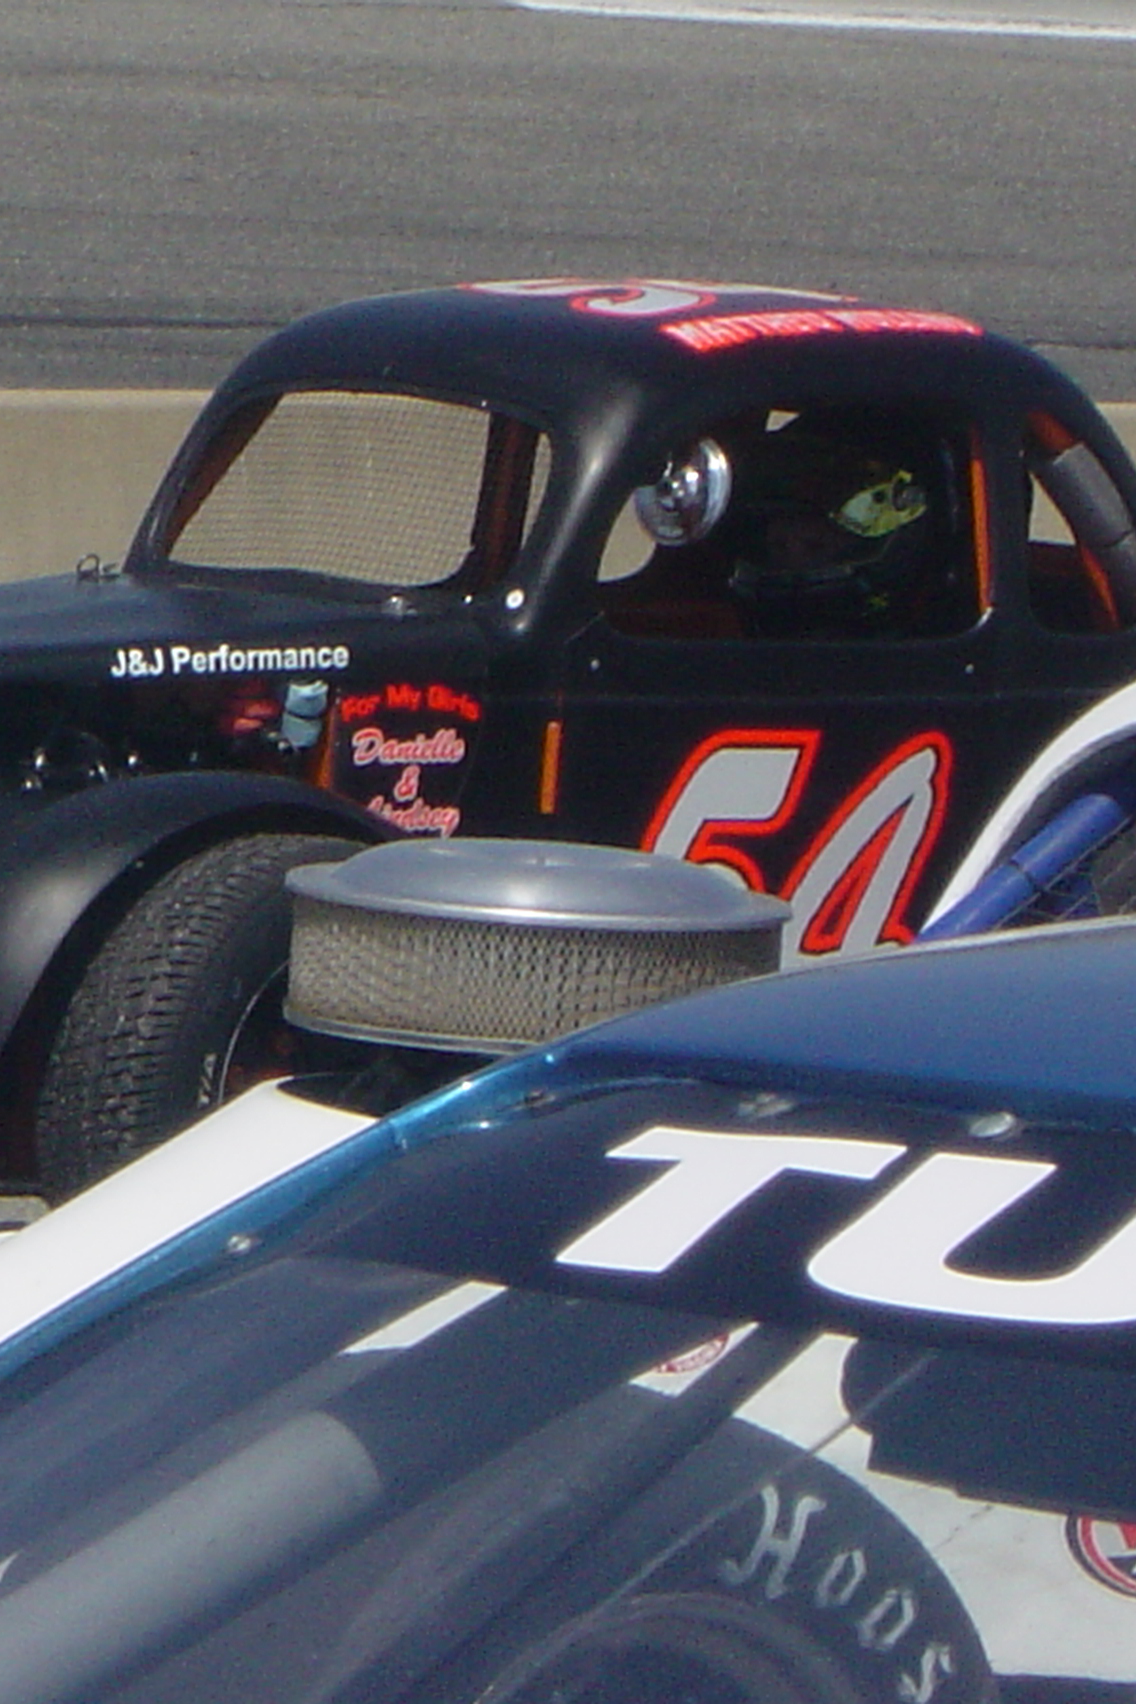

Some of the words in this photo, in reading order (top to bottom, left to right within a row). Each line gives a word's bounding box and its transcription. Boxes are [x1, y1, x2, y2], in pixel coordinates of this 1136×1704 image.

[110, 648, 163, 679] J&J
[170, 644, 350, 675] Performance
[386, 684, 422, 711] My
[352, 727, 466, 766] Danielle
[394, 764, 421, 802] &
